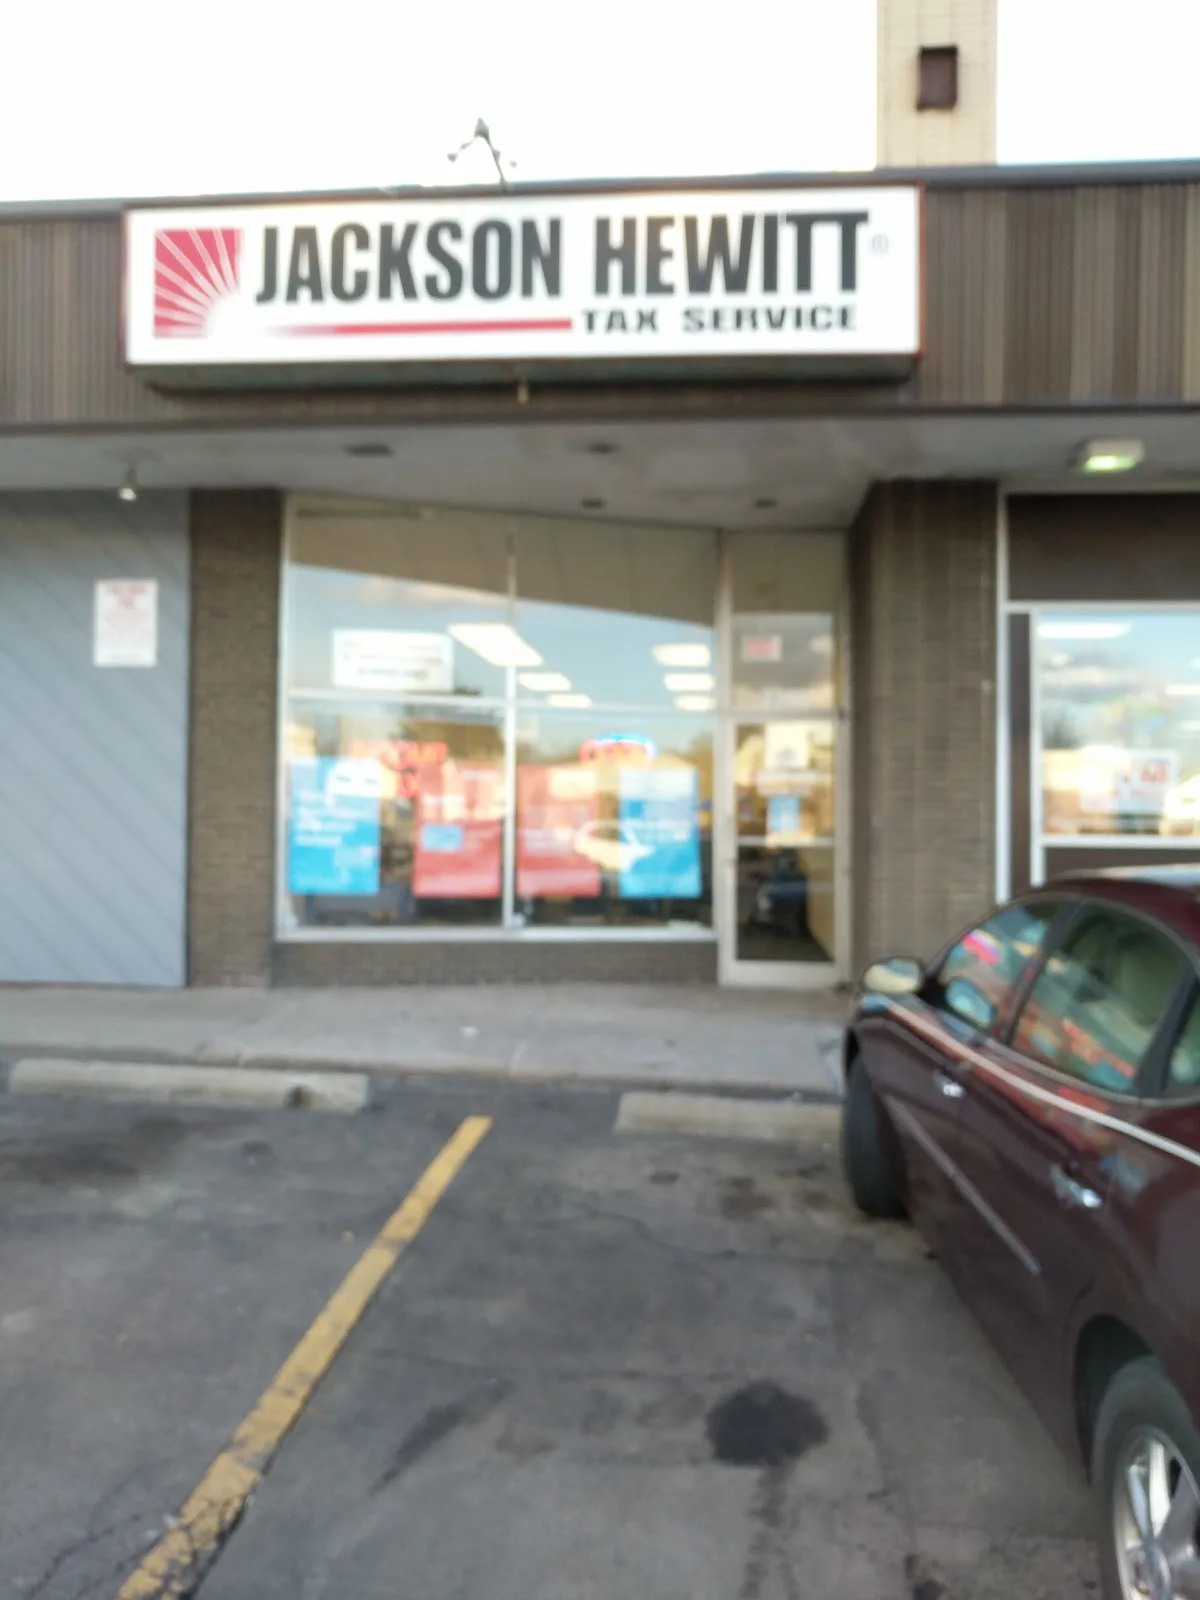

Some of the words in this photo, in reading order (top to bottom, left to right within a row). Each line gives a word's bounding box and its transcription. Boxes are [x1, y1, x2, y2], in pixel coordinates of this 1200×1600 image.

[256, 217, 563, 304] JACKSON
[595, 210, 870, 296] HEWITT
[584, 309, 658, 333] TAX
[682, 305, 856, 332] SERVICE
